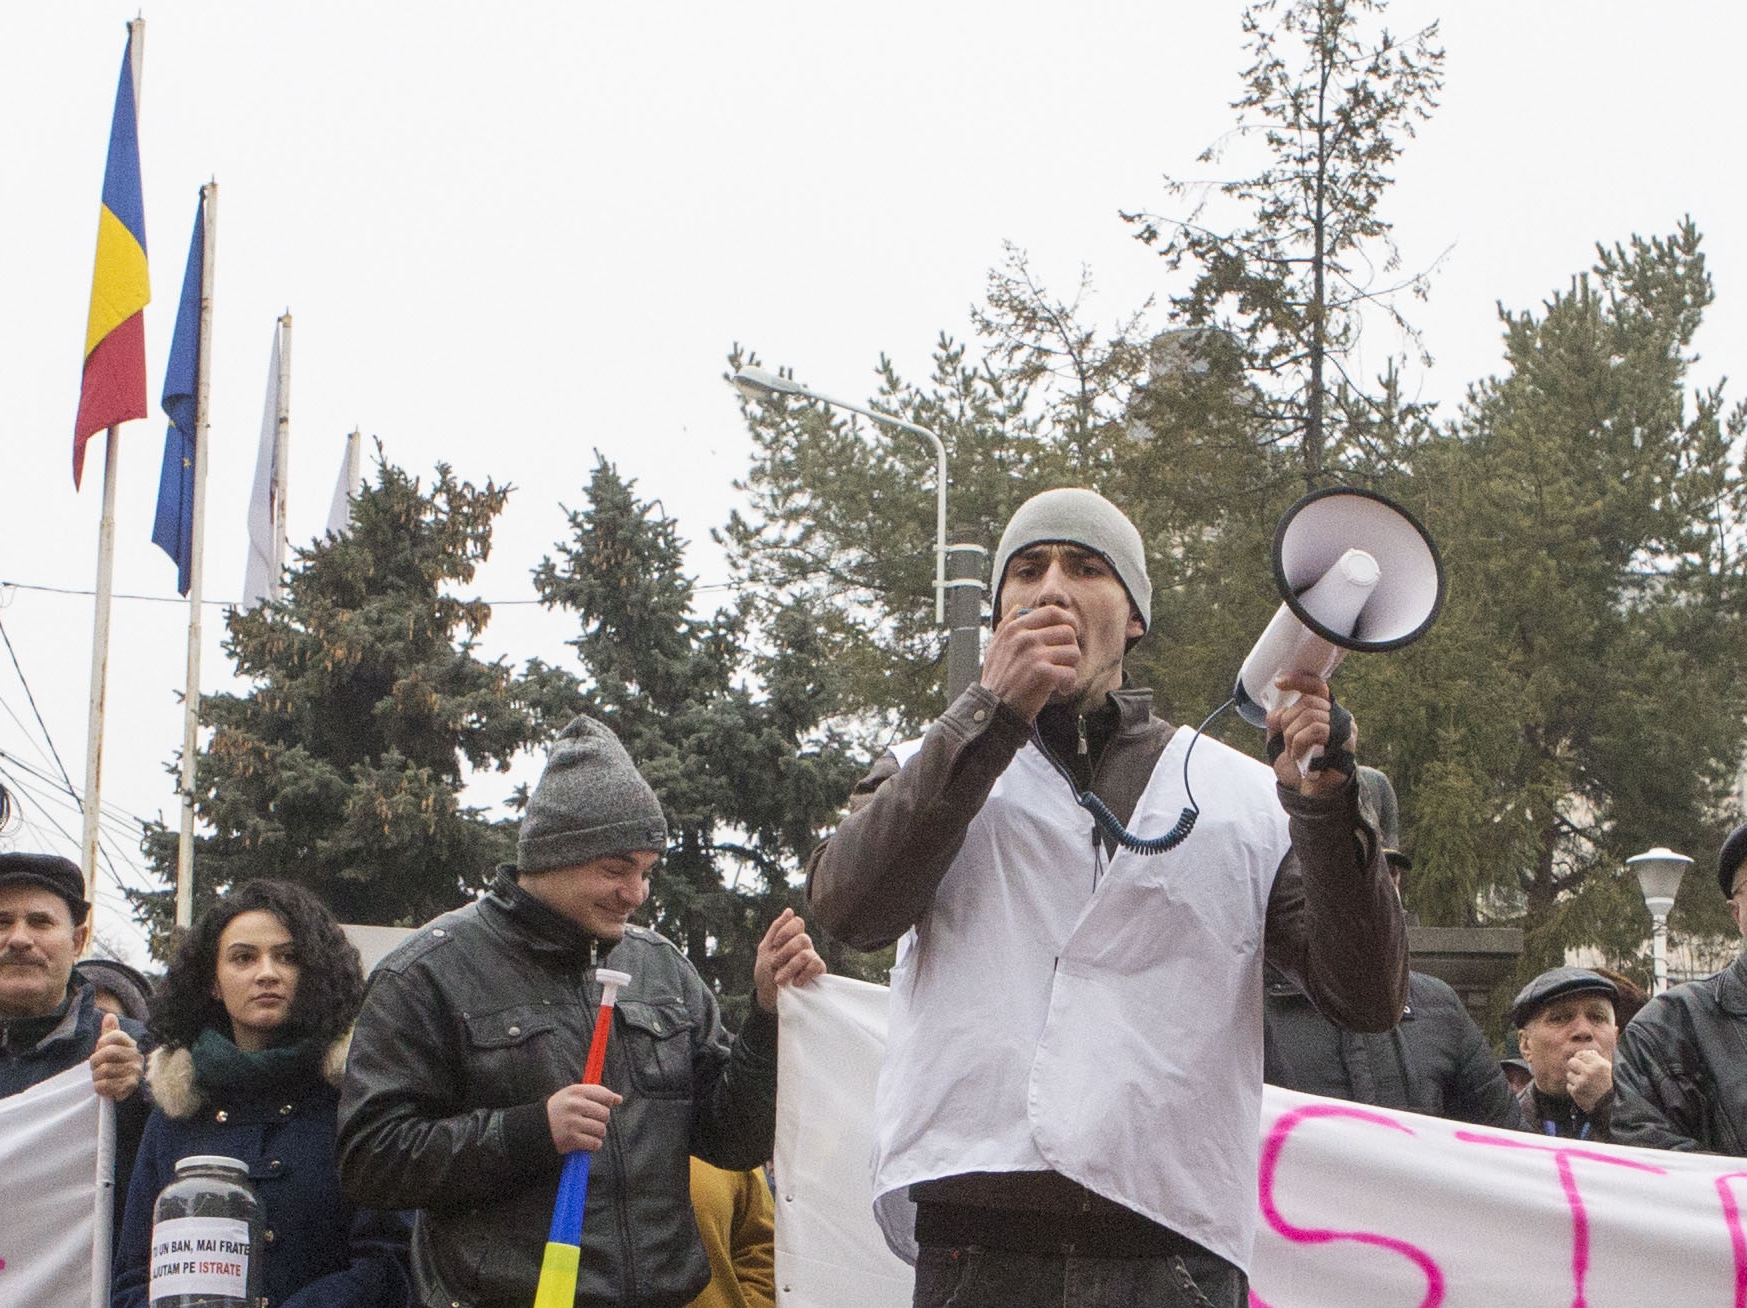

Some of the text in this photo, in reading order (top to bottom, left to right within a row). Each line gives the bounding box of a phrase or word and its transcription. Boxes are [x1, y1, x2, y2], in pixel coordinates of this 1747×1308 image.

[171, 1240, 194, 1254] BAN,
[196, 1239, 217, 1252] MAI
[219, 1240, 251, 1257] FRATE
[182, 1261, 196, 1274] PE
[199, 1261, 242, 1277] ISTRATE
